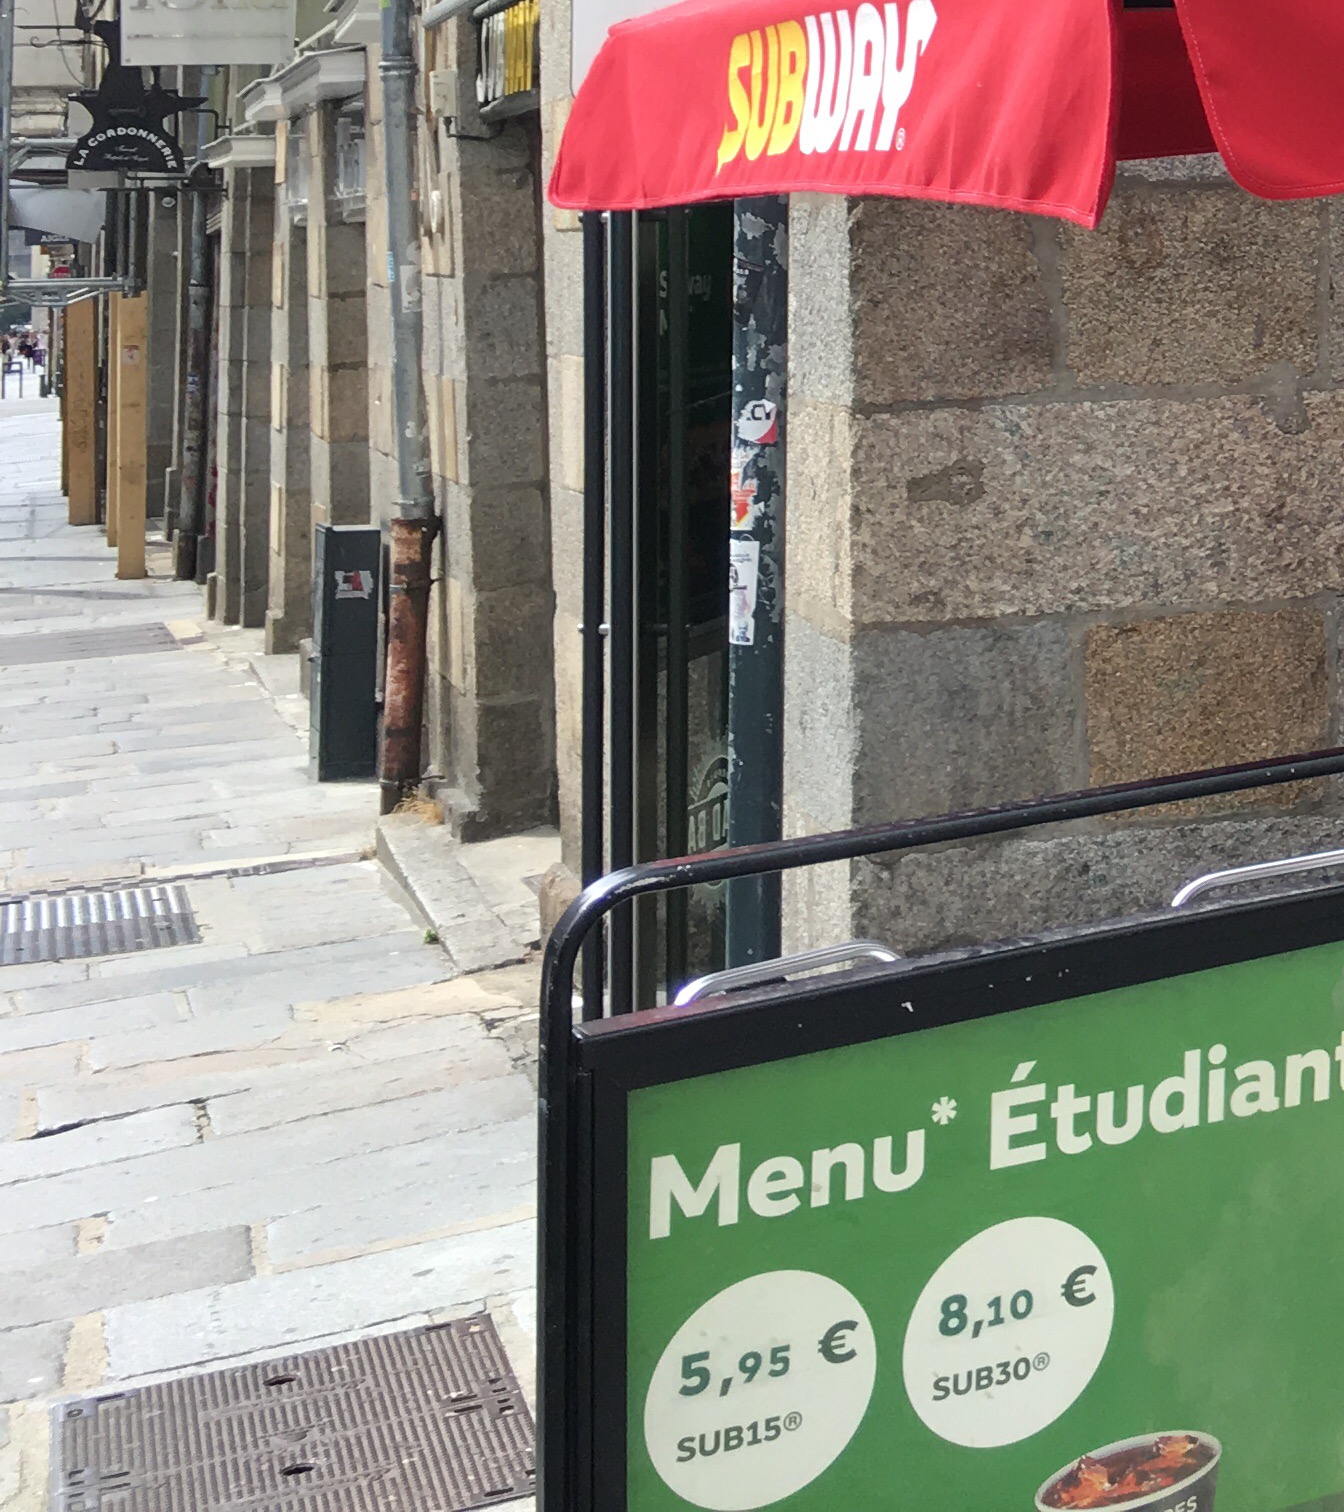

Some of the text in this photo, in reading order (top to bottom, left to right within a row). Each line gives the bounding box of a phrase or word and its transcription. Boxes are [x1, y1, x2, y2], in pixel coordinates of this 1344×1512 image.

[73, 149, 90, 167] LA
[87, 126, 178, 169] CORDONNERIE
[938, 1264, 1099, 1339] 8,10 €
[677, 1319, 859, 1399] 5,95 €
